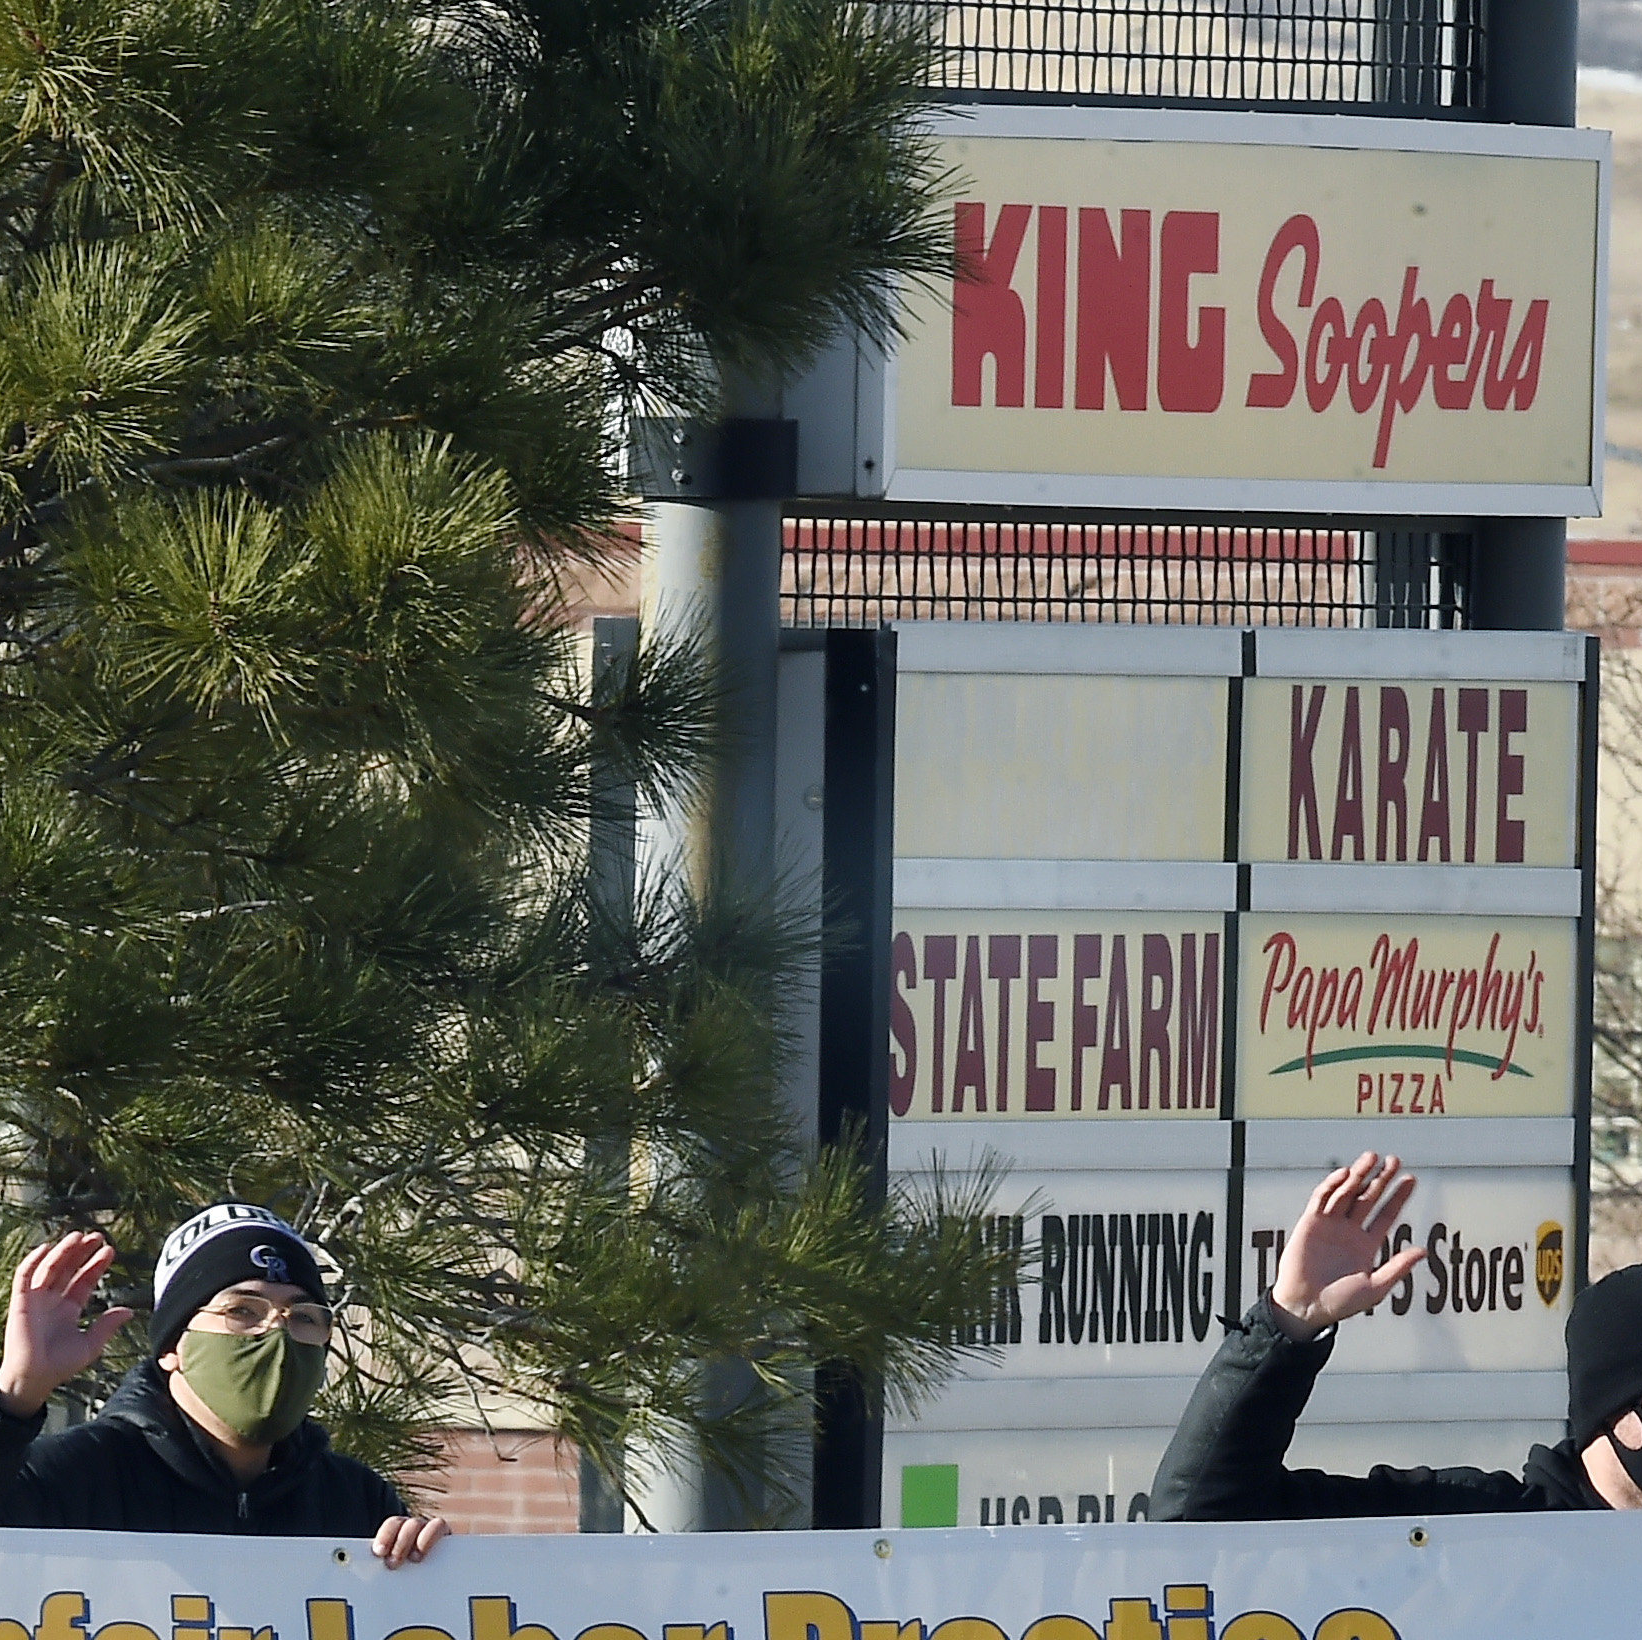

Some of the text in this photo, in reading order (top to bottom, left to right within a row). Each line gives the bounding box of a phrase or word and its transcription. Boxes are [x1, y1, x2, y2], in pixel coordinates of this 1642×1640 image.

[951, 201, 1549, 469] KING Soopers
[1287, 684, 1528, 864] KARATE
[888, 930, 1220, 1118] STATE FARM
[1259, 931, 1544, 1081] Papa Murphy's
[1357, 1072, 1445, 1114] PIZZA
[1039, 1210, 1214, 1344] RUNNING
[1426, 1222, 1524, 1313] Store
